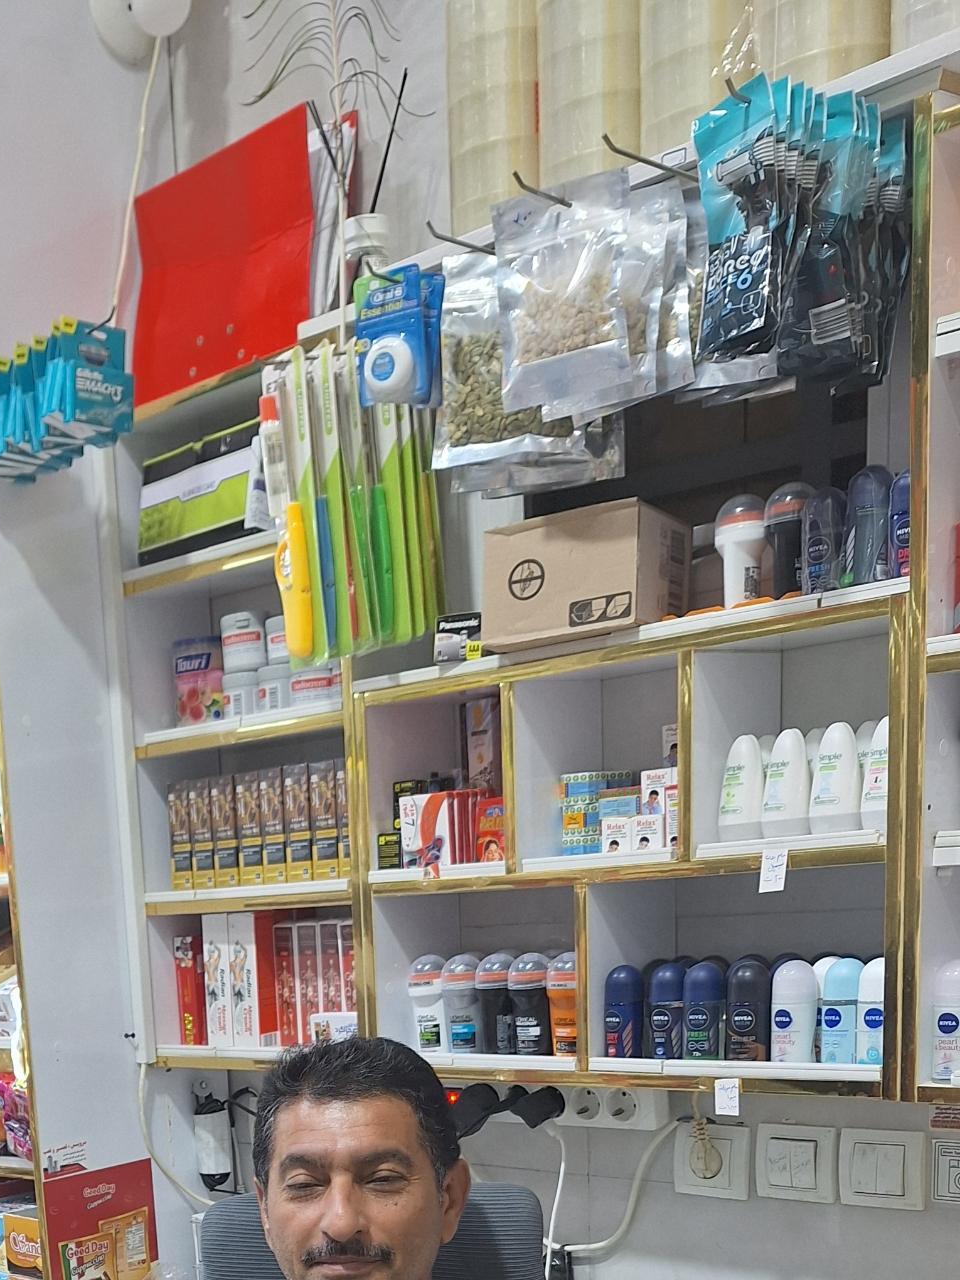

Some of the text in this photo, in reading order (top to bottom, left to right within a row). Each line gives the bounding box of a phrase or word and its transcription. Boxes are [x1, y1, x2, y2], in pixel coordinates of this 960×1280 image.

[809, 544, 829, 553] NIVEA
[438, 616, 480, 635] Panasonic
[819, 753, 843, 763] Simple
[937, 1038, 958, 1047] pearl
